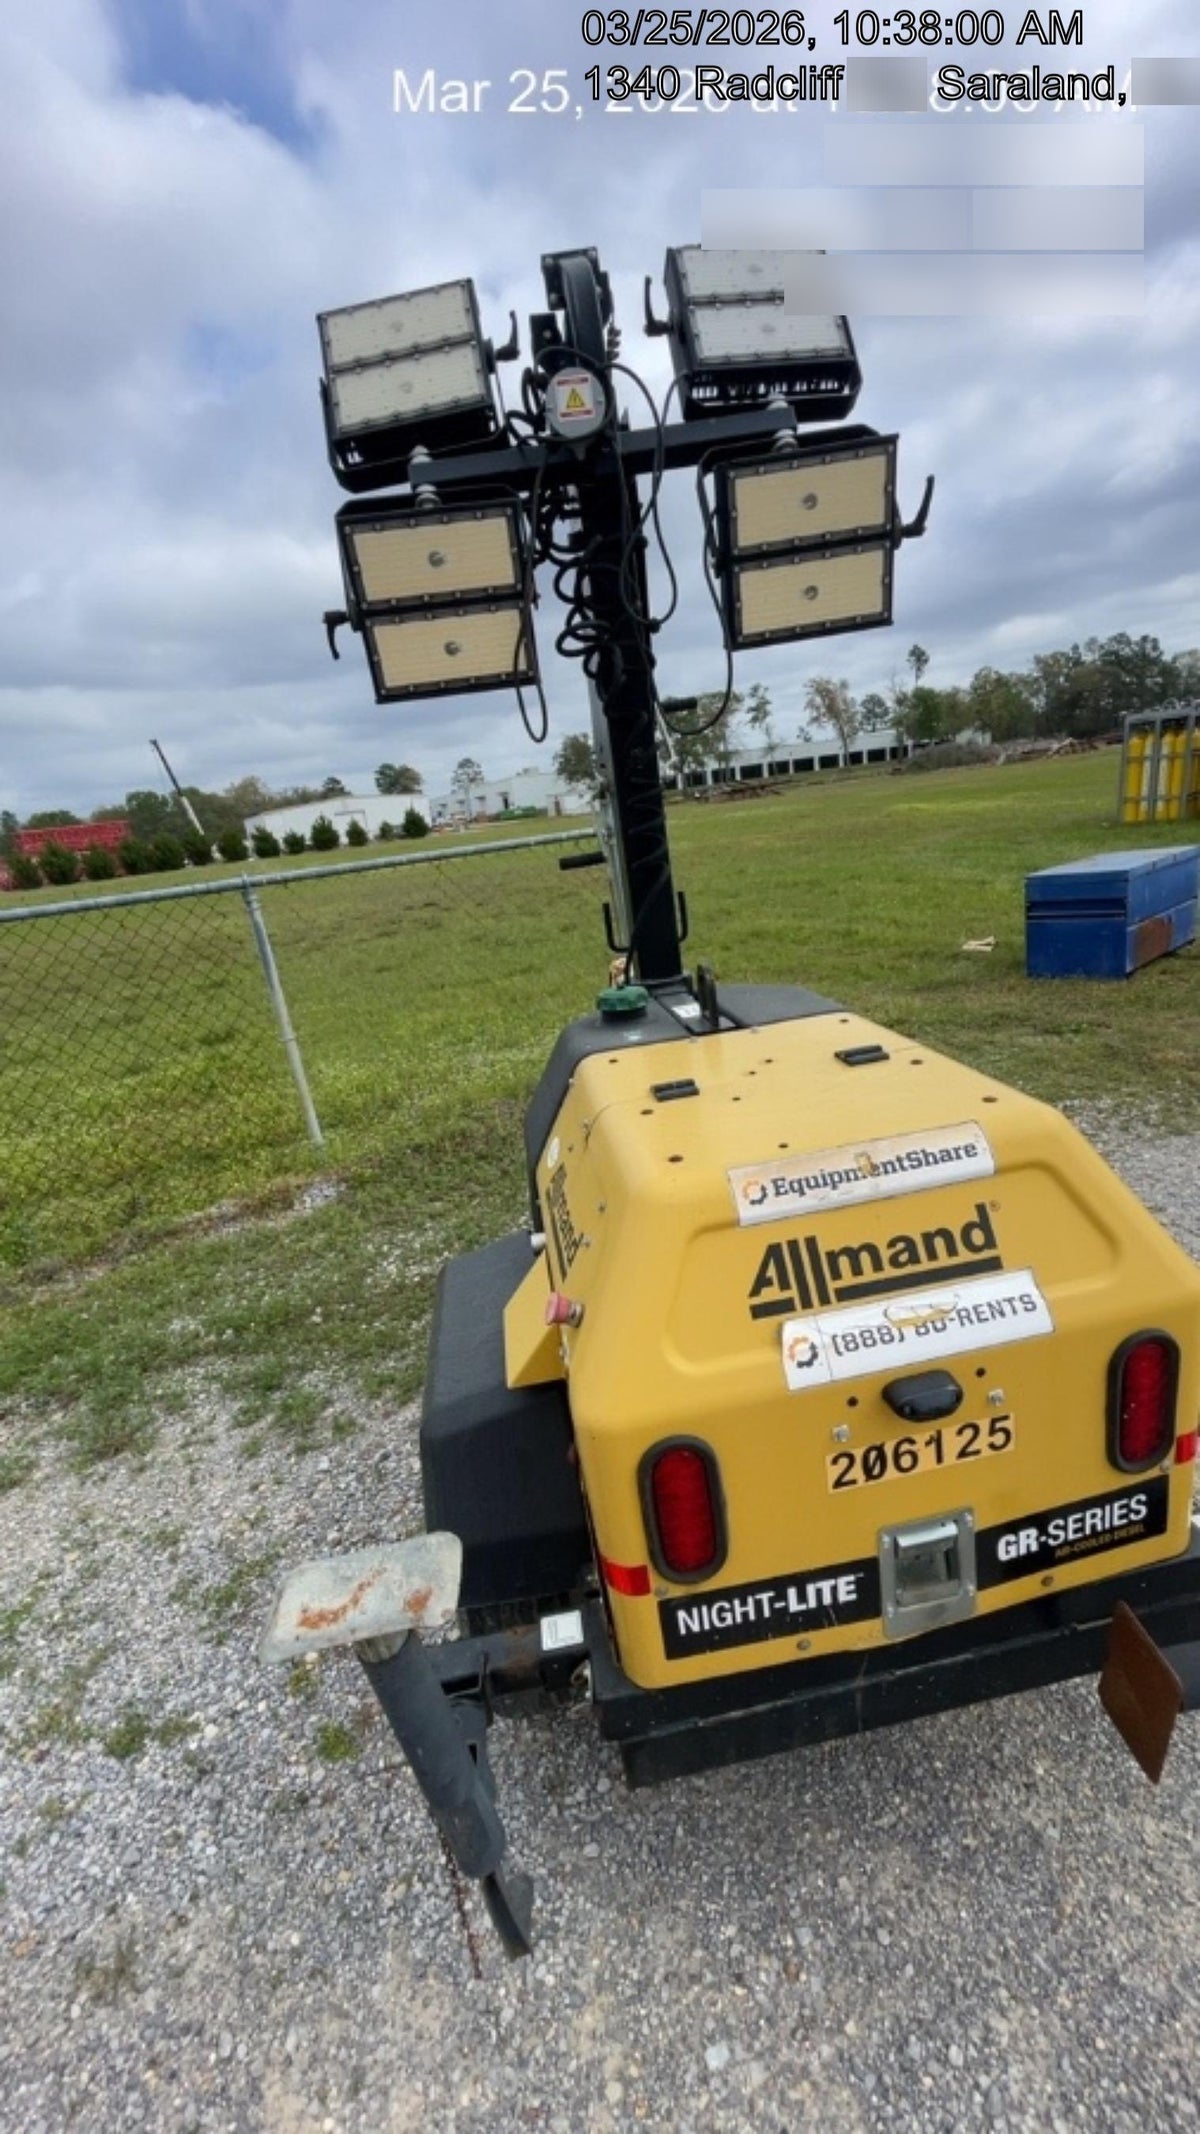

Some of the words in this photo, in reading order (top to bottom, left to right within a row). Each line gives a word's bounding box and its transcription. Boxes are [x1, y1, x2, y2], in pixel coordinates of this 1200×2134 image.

[771, 1141, 978, 1199] EquipmentShare
[748, 1201, 999, 1311] Allmand
[830, 1414, 1013, 1491] 206125
[997, 1493, 1148, 1562] GR-SERIES
